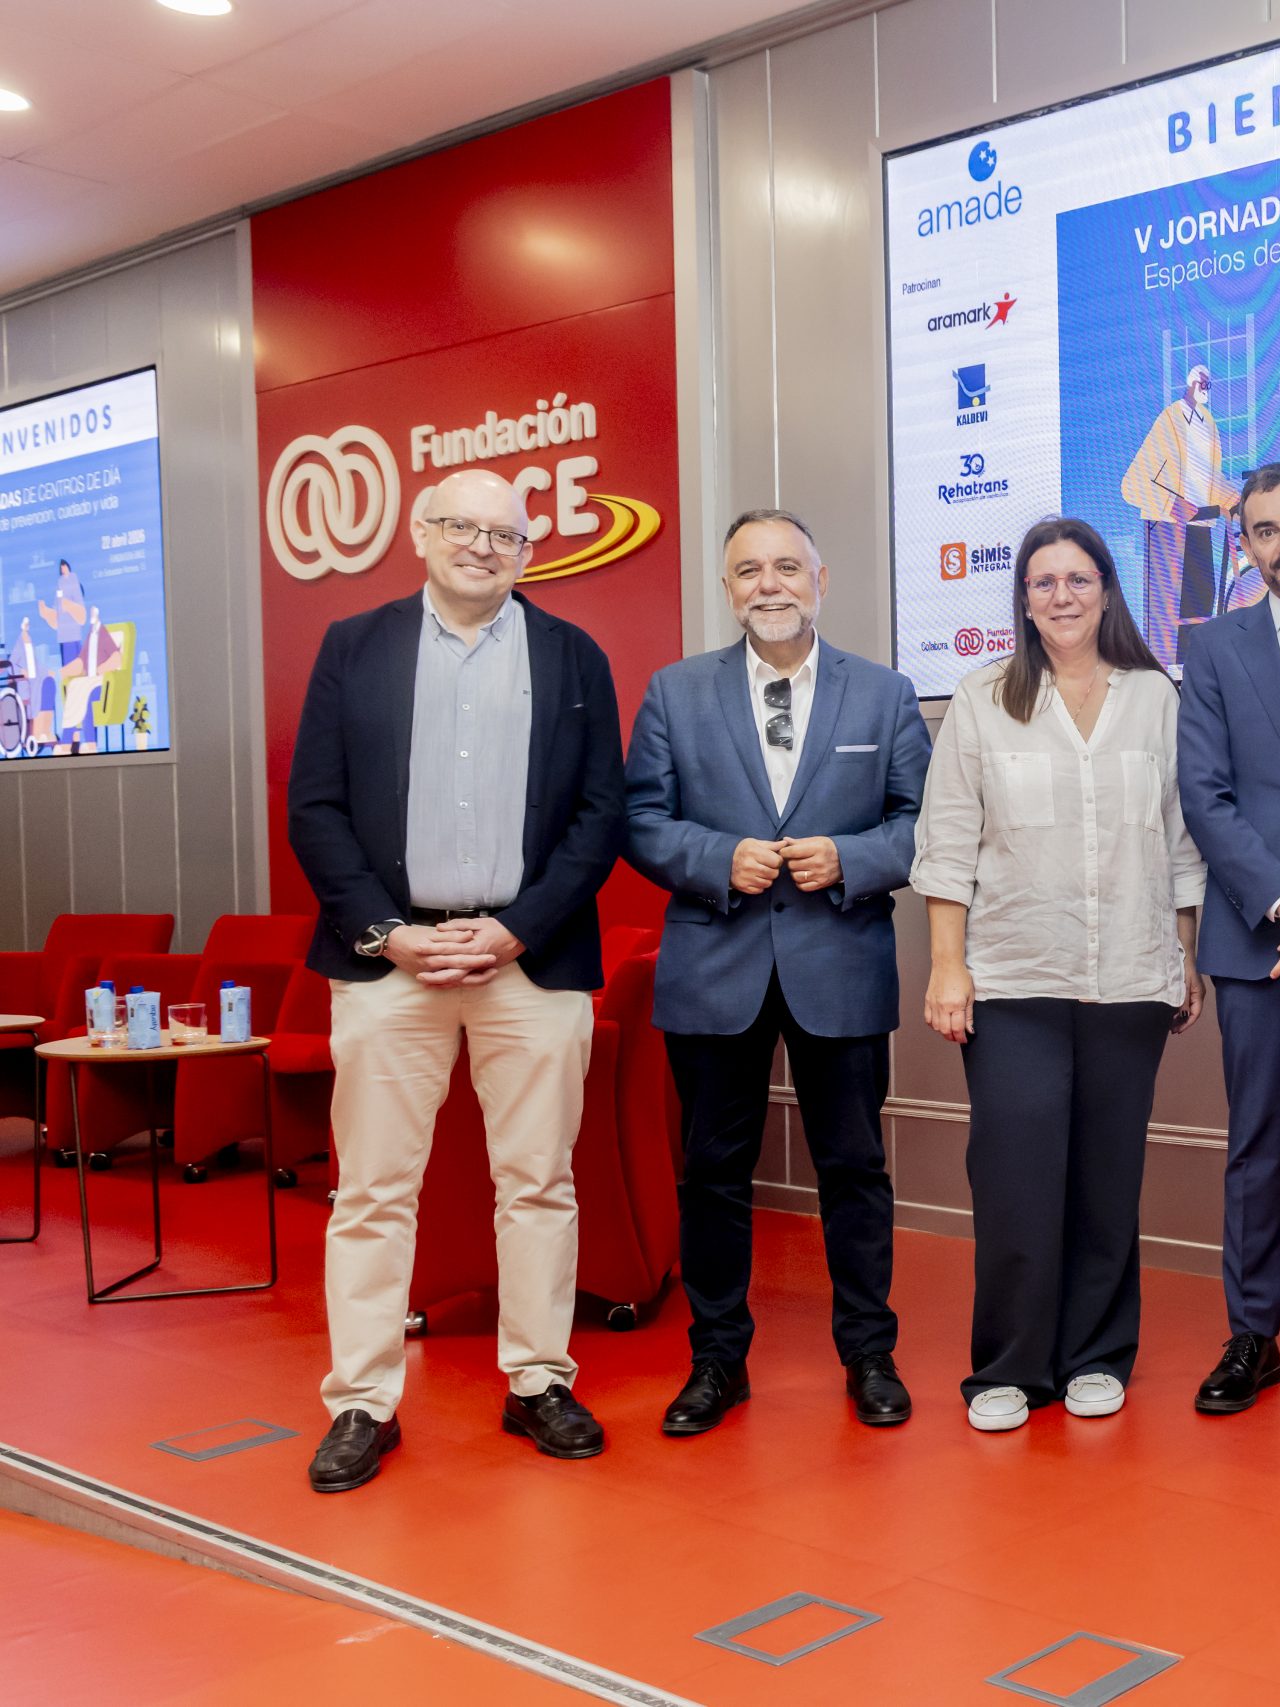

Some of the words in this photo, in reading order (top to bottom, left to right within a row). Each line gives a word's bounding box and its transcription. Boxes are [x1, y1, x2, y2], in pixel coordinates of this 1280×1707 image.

[917, 180, 1023, 237] amade
[1134, 223, 1156, 254] V
[1144, 249, 1245, 291] Espacios
[902, 277, 941, 295] Patrocinan
[927, 301, 991, 331] aramark
[2, 404, 113, 456] NVENIDOS
[410, 391, 598, 473] Fundación
[960, 453, 985, 477] 30
[0, 490, 22, 510] DAS
[23, 486, 37, 505] DE
[38, 475, 84, 501] CENTROS
[87, 471, 101, 491] DE
[938, 479, 1009, 504] Rehatrans
[971, 561, 1012, 574] INTEGRAL
[921, 640, 949, 652] Colabora
[986, 628, 1015, 637] Fundac
[987, 638, 1015, 652] ONC
